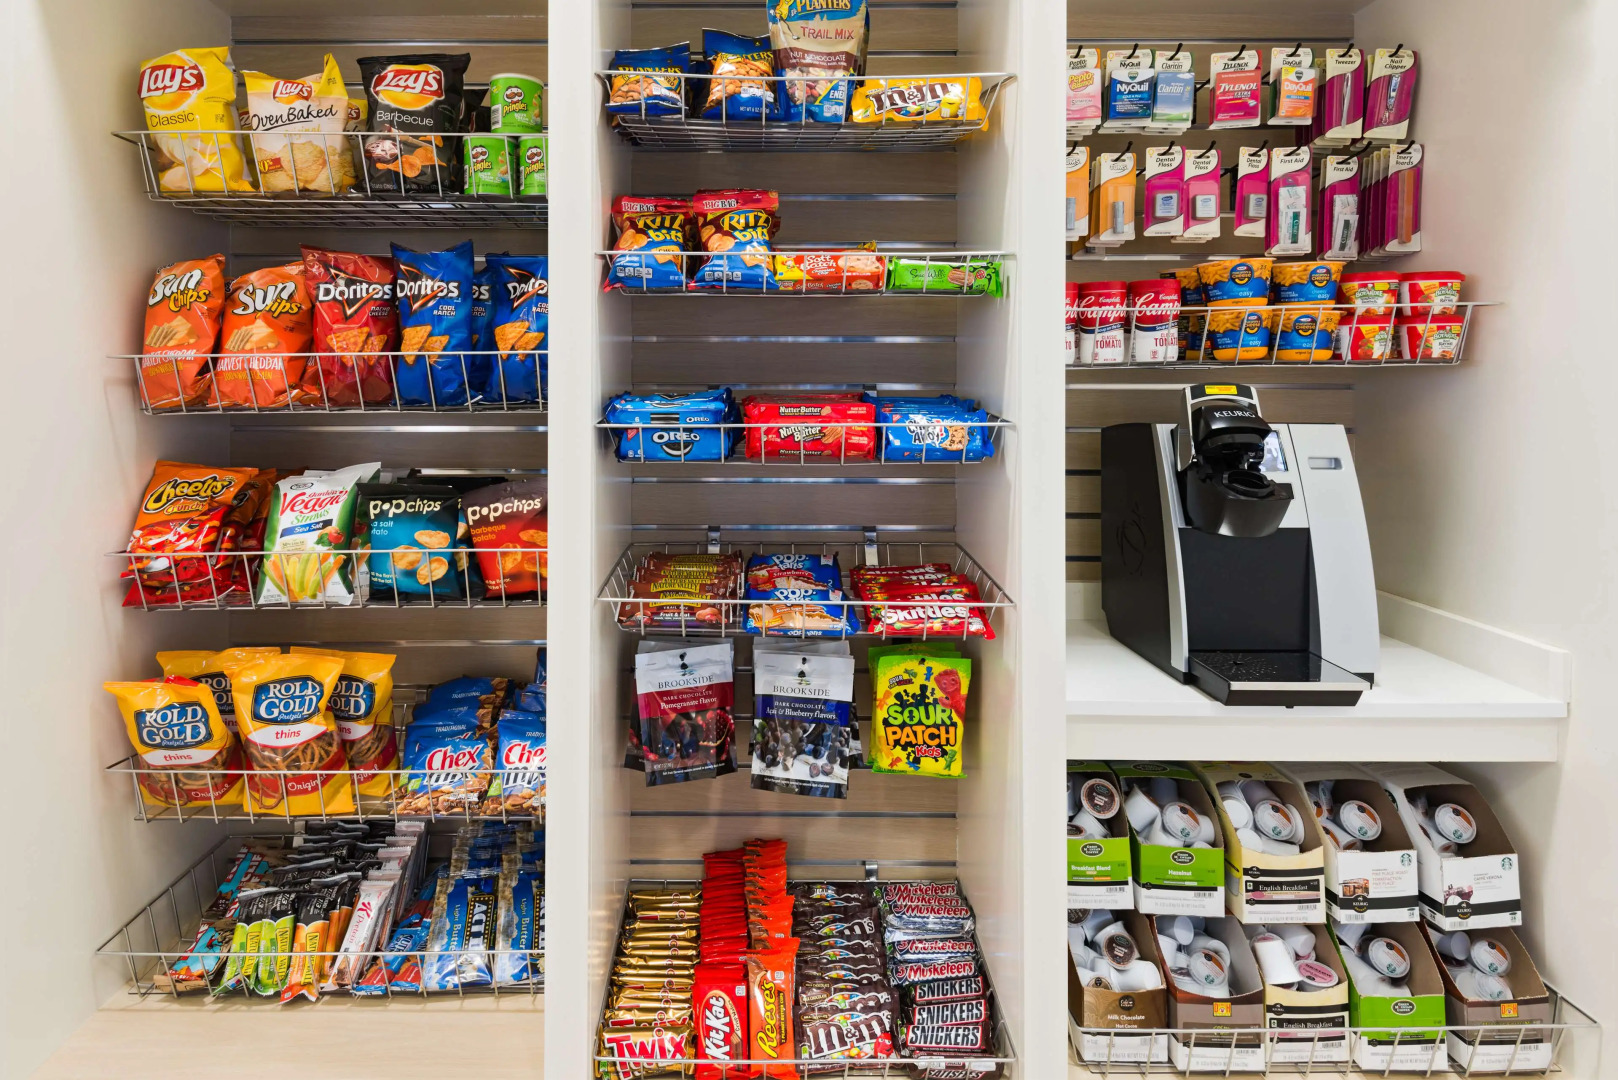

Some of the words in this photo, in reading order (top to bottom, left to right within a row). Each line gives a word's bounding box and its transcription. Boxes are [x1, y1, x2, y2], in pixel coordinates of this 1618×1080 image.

[800, 26, 832, 39] TRAIL
[835, 28, 854, 40] MIX
[790, 52, 803, 60] NUT
[811, 53, 846, 62] CHOCOLATE
[1222, 62, 1248, 70] TYLENOL
[141, 66, 198, 98] Lay's
[376, 70, 441, 94] Lay's
[1117, 83, 1148, 93] NyQuil
[1158, 84, 1183, 94] Claritin
[1219, 83, 1257, 93] TYLENOL
[1284, 82, 1312, 92] DayQuil
[275, 80, 311, 100] Lay's
[503, 101, 527, 116] Pringles
[150, 111, 195, 127] Classic
[376, 110, 434, 127] Barbecue
[622, 202, 638, 211] BIG
[639, 203, 655, 212] BAG
[703, 200, 720, 209] BIG
[721, 199, 737, 208] BAG
[637, 214, 684, 229] RITZ
[722, 212, 769, 231] RITZ
[648, 229, 684, 243] bits
[732, 227, 769, 242] bits
[149, 269, 202, 307] Sun
[319, 282, 393, 301] Doritos
[397, 279, 459, 298] Doritos
[169, 289, 210, 312] Chips
[232, 281, 296, 315] Sun
[1096, 340, 1121, 348] TOMATO
[1214, 410, 1255, 418] KEURIG
[652, 431, 700, 443] OREO
[144, 474, 233, 513] Cheetos
[164, 501, 206, 515] Crunchy
[280, 489, 348, 516] Veggie
[370, 498, 441, 519] popchips
[467, 498, 541, 525] popchips
[470, 524, 506, 535] barbeque
[473, 533, 496, 543] potato
[652, 583, 675, 591] NATURE
[676, 583, 698, 592] VALLEY
[881, 606, 969, 624] Skittles
[268, 681, 320, 698] ROLD
[658, 674, 714, 690] BROOKSIDE
[679, 690, 713, 699] CHOCOLATE
[772, 685, 831, 697] BROOKSIDE
[260, 695, 317, 719] GOLD
[661, 700, 699, 710] Pomegranate
[791, 702, 826, 710] CHOCOLATE
[145, 705, 202, 726] ROLD
[785, 708, 814, 719] Blueberry
[814, 709, 836, 720] flavors
[888, 705, 951, 725] SOUR
[143, 722, 206, 742] GOLD
[275, 730, 301, 740] thins
[886, 727, 956, 746] PATCH
[164, 753, 192, 761] thins
[427, 744, 484, 771] Chex
[915, 745, 941, 757] Kids
[897, 883, 956, 896] Musketeers
[905, 905, 970, 917] Musketeers
[519, 917, 530, 949] Butter
[909, 940, 974, 952] Musketeers
[908, 962, 974, 979] Musketeers
[918, 978, 982, 999] SNICKERS
[757, 980, 778, 1058] Reese's
[917, 1001, 983, 1025] SNICKERS
[909, 1026, 979, 1047] SNICKERS
[606, 1033, 687, 1079] Twix
